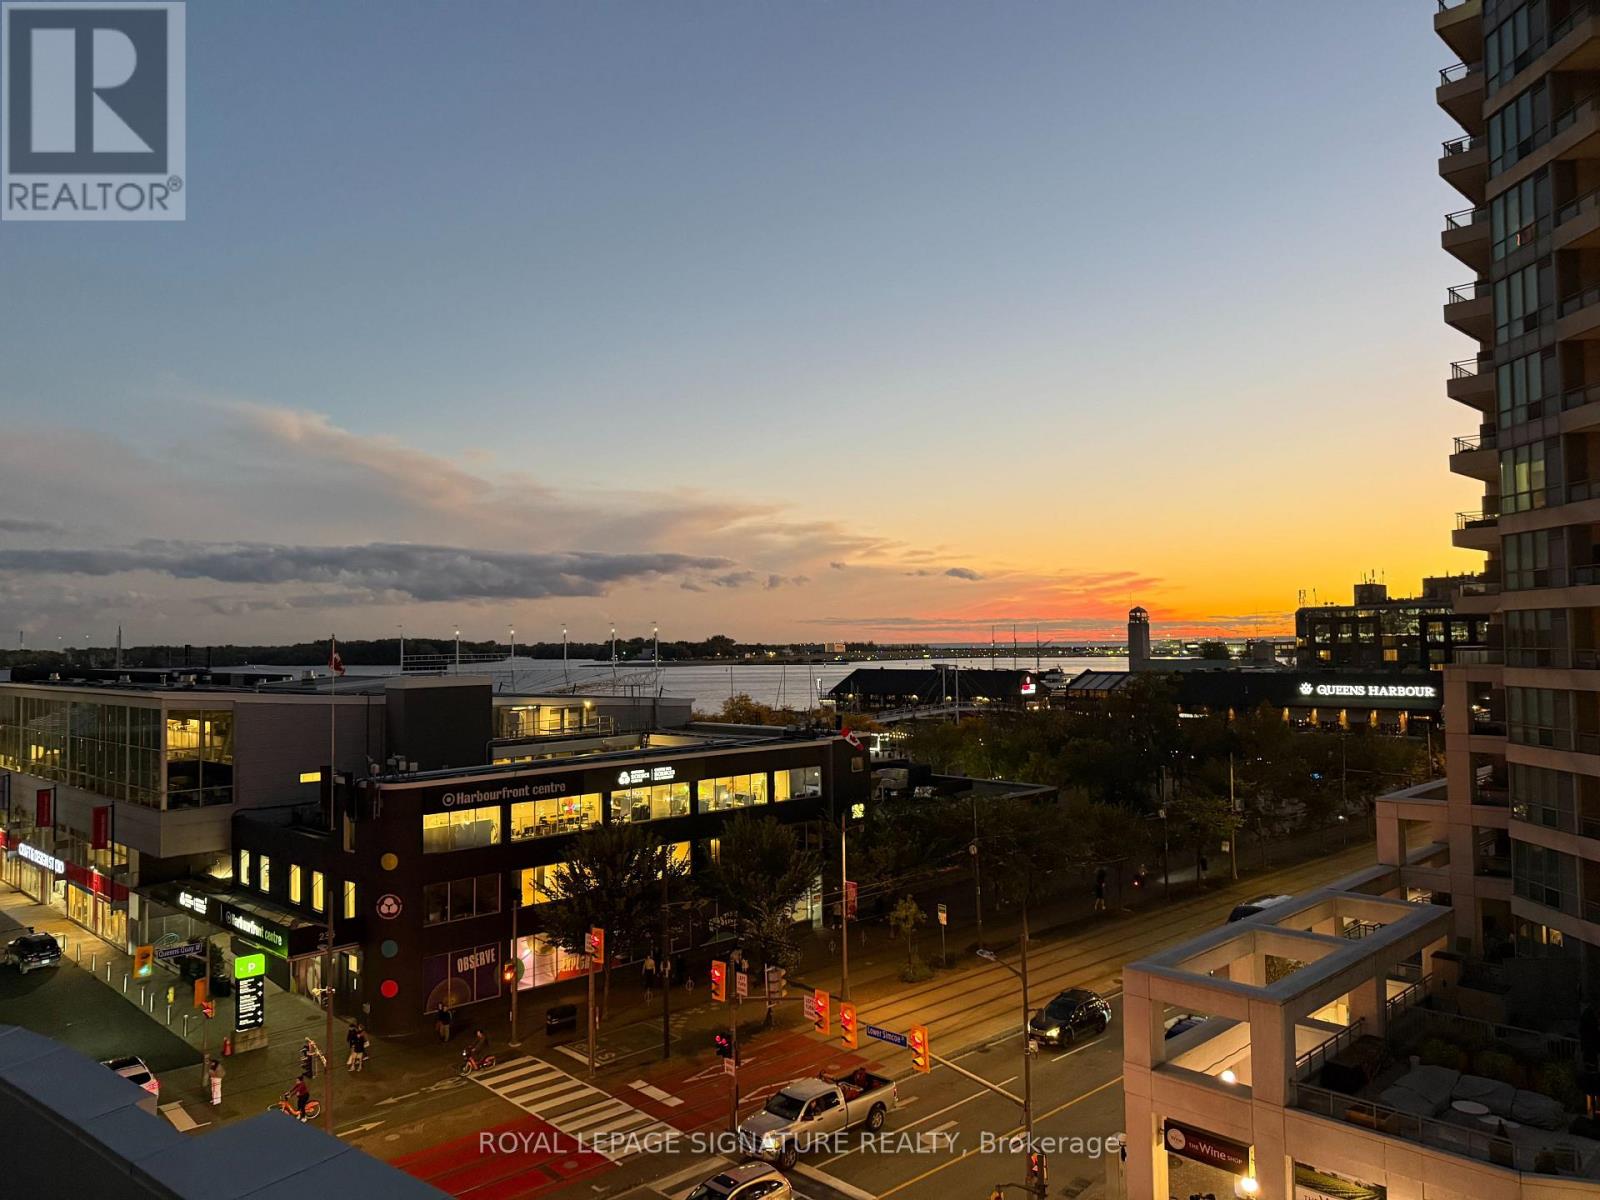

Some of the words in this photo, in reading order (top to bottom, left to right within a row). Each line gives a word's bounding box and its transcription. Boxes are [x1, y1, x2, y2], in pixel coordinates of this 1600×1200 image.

[1316, 684, 1366, 696] QUEENS
[1367, 685, 1436, 697] HARBOUR
[456, 786, 529, 805] Harbourfront
[532, 782, 566, 796] centre
[231, 913, 264, 938] Harbourfront
[264, 930, 283, 946] centre
[457, 948, 496, 973] OBSERVE
[868, 1026, 882, 1037] Lower
[882, 1031, 901, 1043] Simcoe
[1188, 1142, 1199, 1151] THE
[1198, 1141, 1226, 1161] Wine
[1226, 1154, 1243, 1164] SHOP
